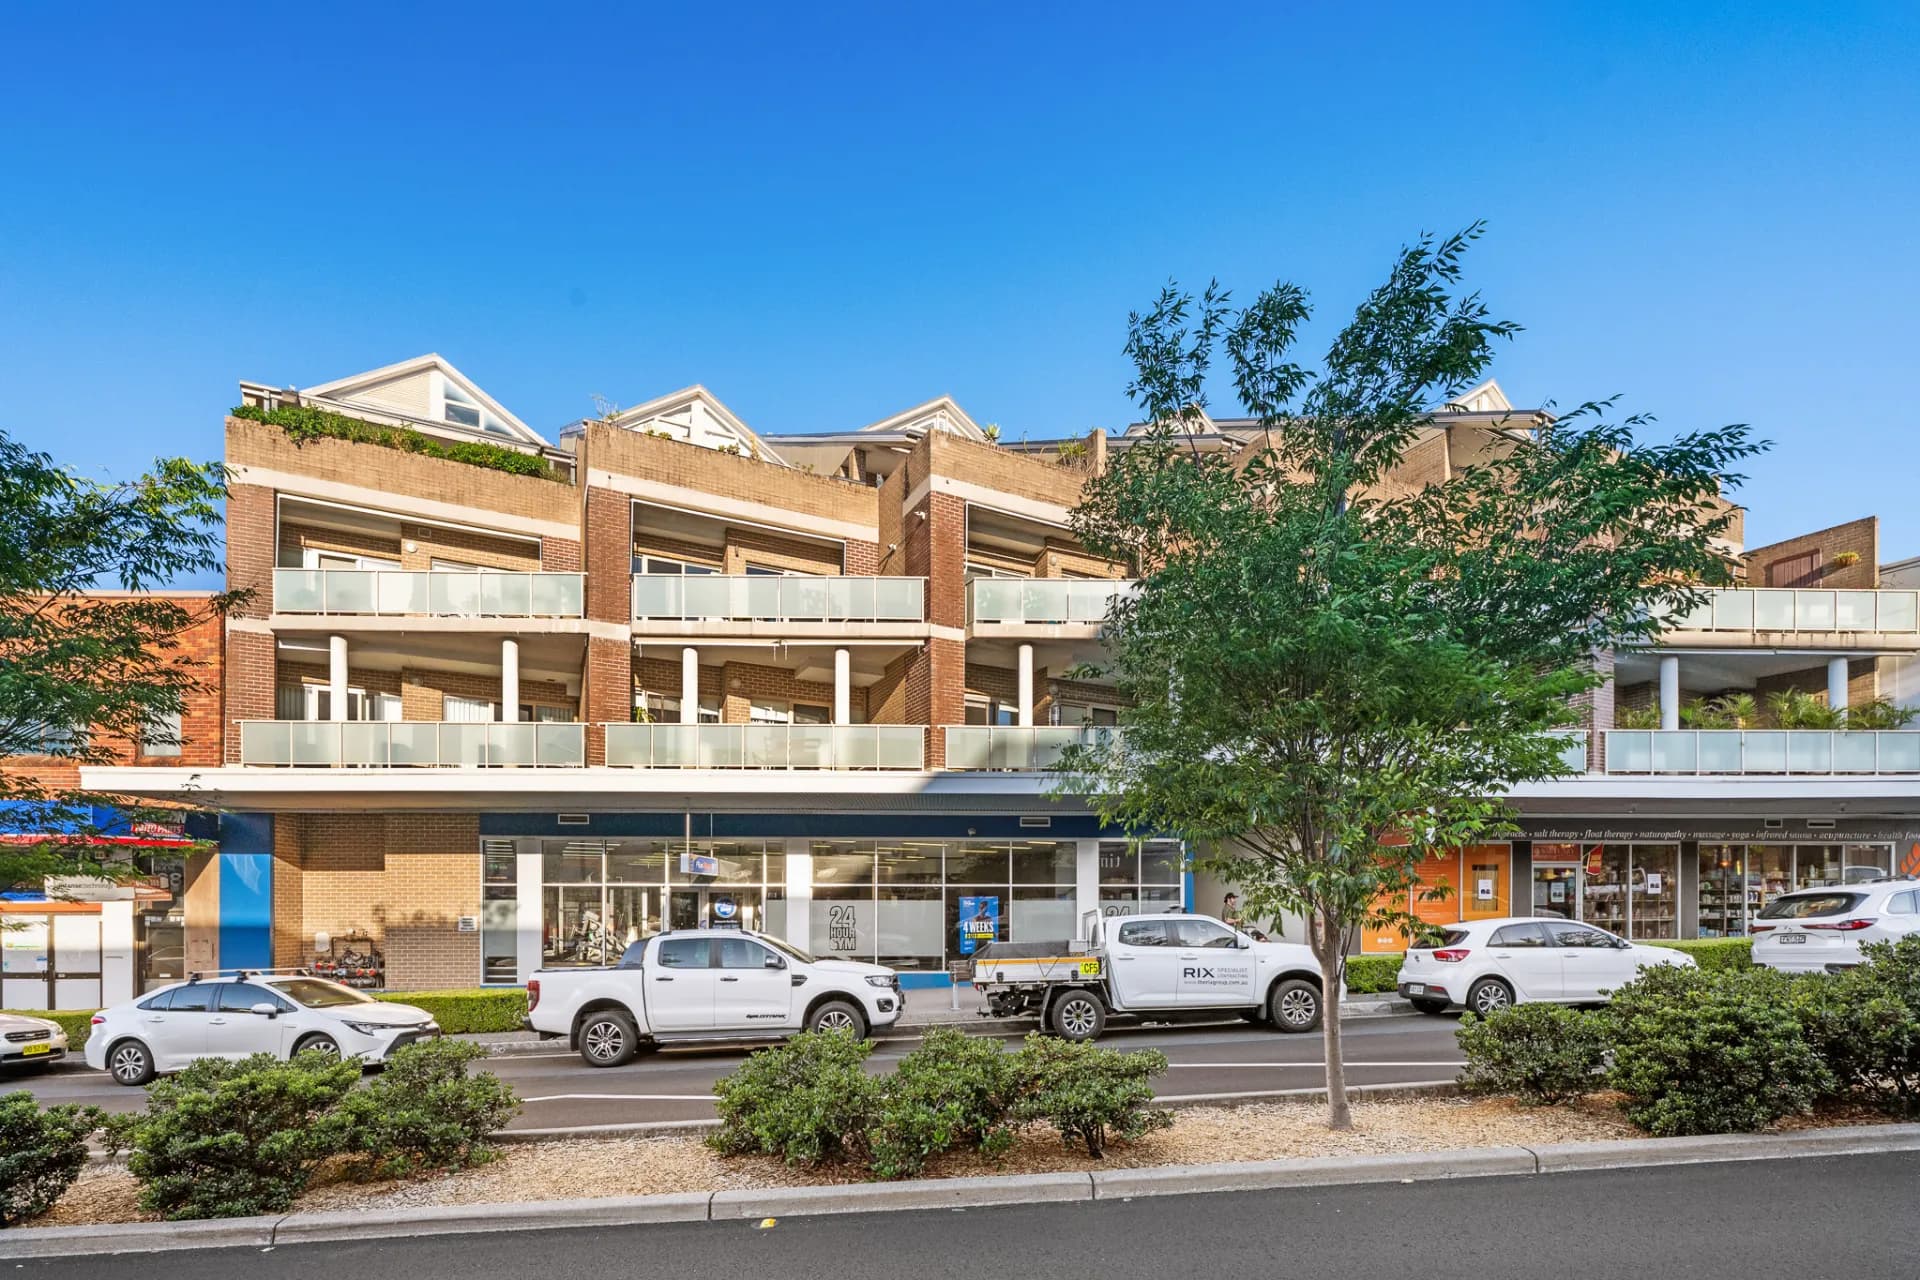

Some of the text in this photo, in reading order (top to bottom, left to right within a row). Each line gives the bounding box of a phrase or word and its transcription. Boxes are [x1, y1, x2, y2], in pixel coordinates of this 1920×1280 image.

[157, 823, 182, 834] PARTS
[1534, 829, 1548, 838] salt
[1549, 829, 1579, 840] therapy
[1583, 829, 1602, 840] float
[1604, 829, 1634, 840] therapy
[1639, 829, 1687, 841] naturopathy
[1693, 832, 1726, 840] massage
[1756, 830, 1788, 840] infrared
[1819, 831, 1871, 841] acupuncture
[830, 905, 856, 928] 24
[830, 927, 856, 938] HOUR
[969, 921, 994, 933] WEEKS
[830, 938, 856, 951] GYM
[1184, 967, 1215, 978] RIX
